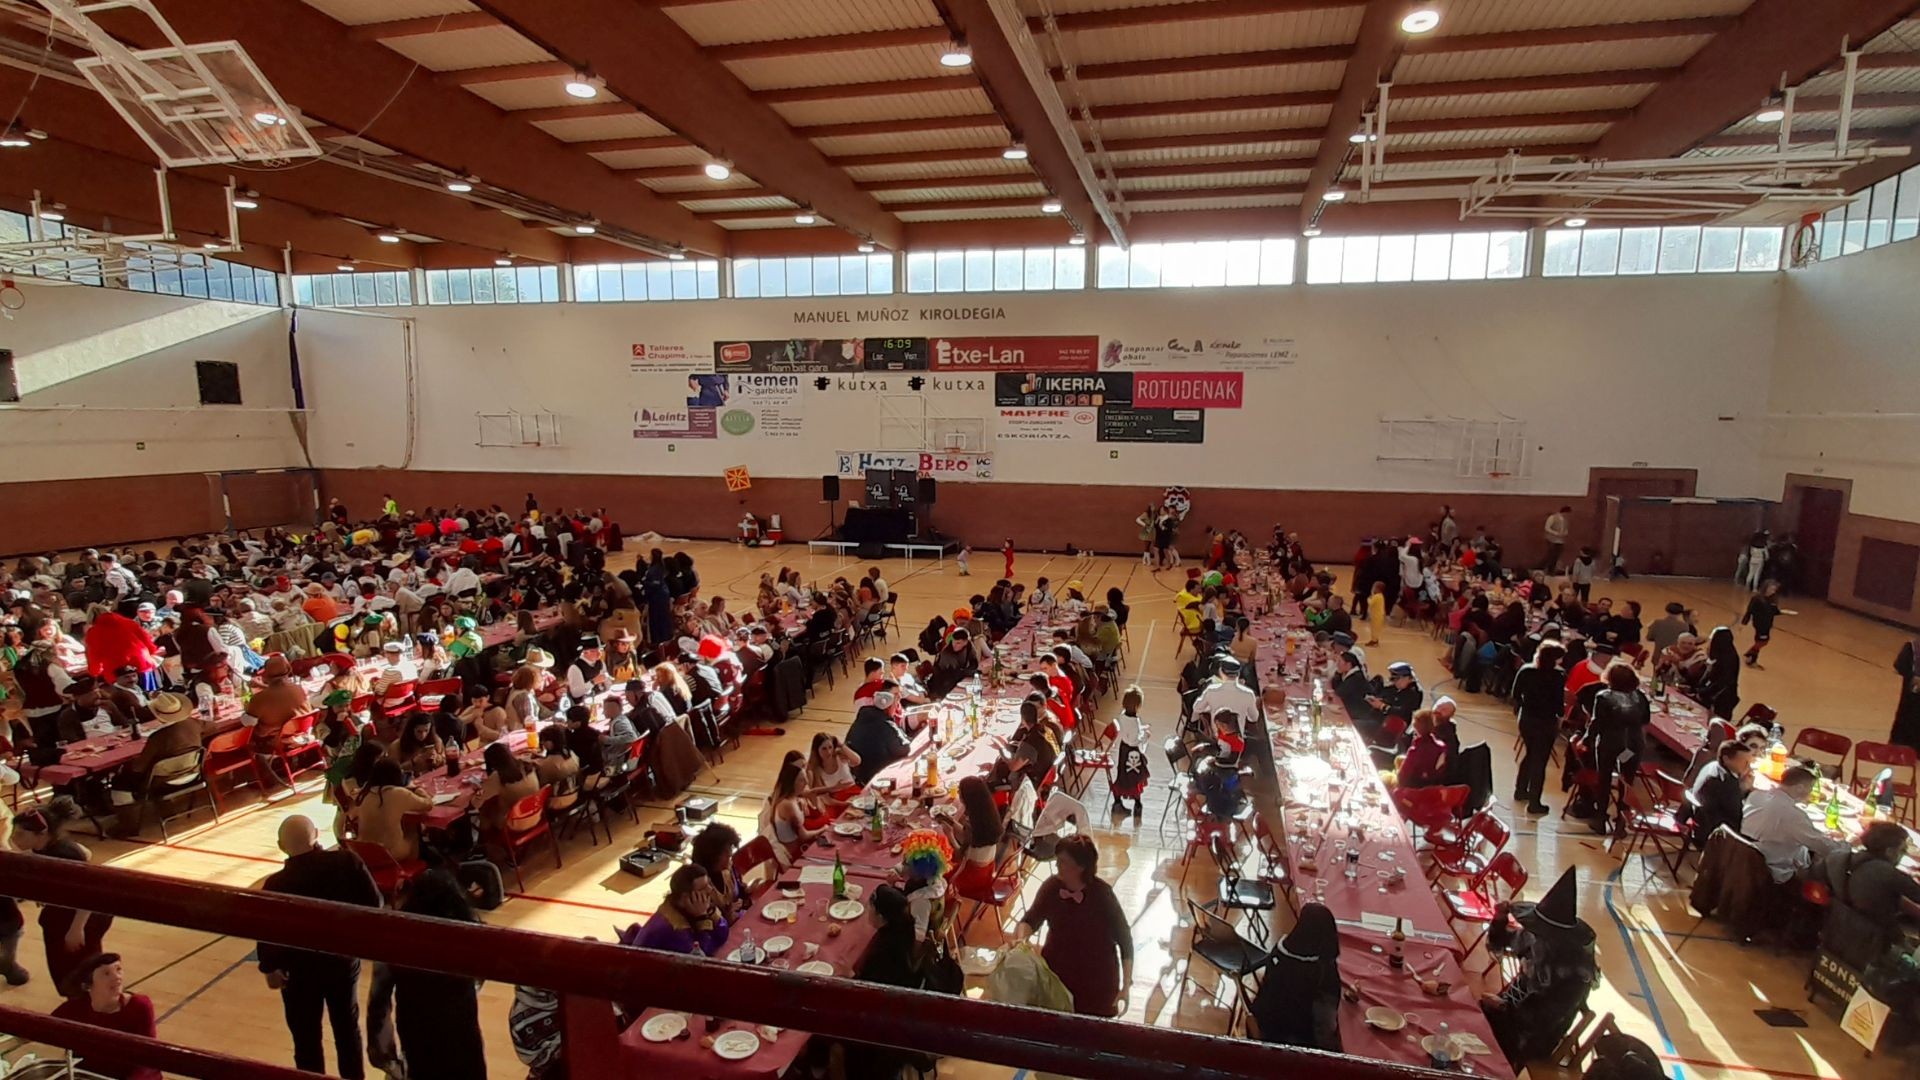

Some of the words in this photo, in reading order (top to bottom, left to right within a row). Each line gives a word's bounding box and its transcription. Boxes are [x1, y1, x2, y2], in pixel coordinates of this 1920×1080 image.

[793, 311, 850, 323] MANUEL
[856, 308, 909, 322] MUÑOZ
[920, 307, 1006, 321] KIROLDEGIA
[936, 339, 1025, 364] Etxe-Lan
[767, 364, 791, 372] Team
[738, 376, 798, 394] Hemen
[755, 386, 798, 395] garbiketak
[838, 377, 887, 391] kutxa
[933, 376, 985, 391] kutxa
[1046, 377, 1106, 392] IKERRA
[1138, 379, 1237, 400] ROTUDENAK
[918, 453, 969, 471] BERO
